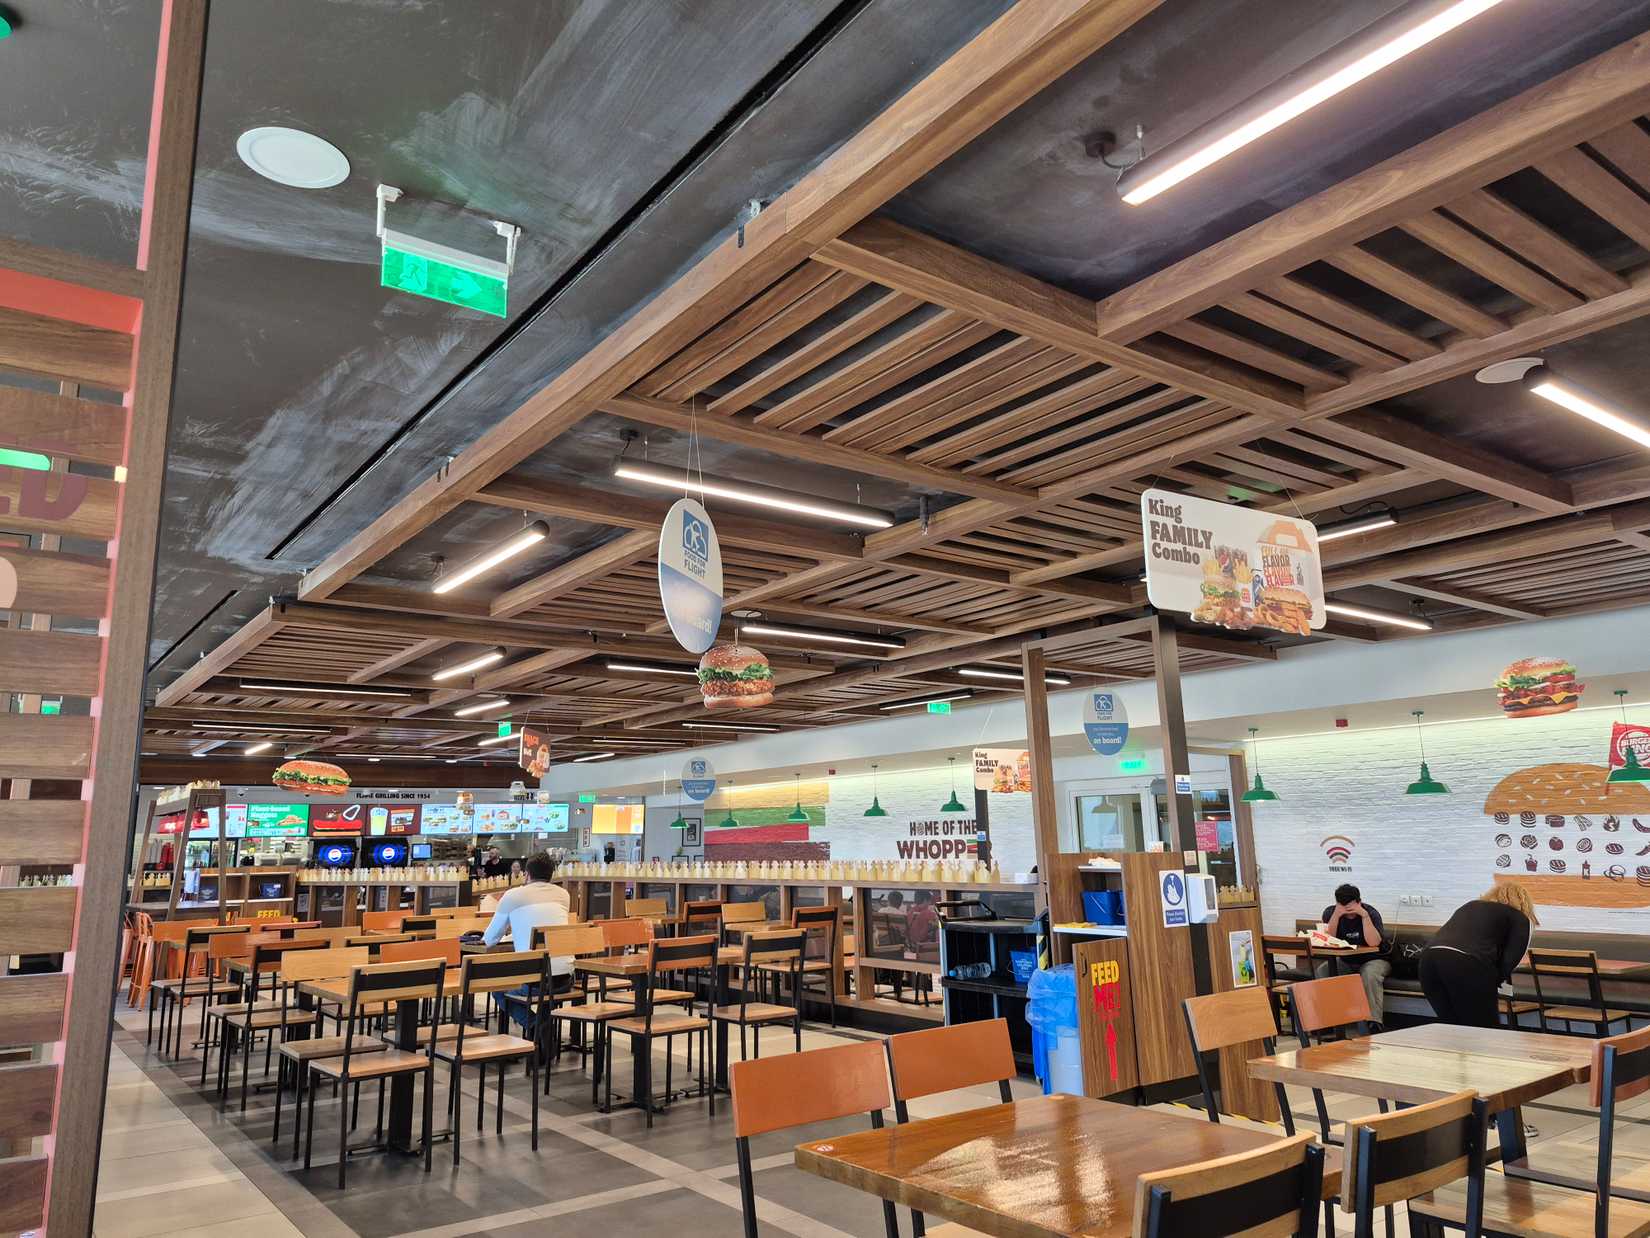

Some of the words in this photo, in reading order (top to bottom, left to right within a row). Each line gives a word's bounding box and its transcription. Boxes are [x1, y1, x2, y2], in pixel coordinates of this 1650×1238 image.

[1148, 498, 1183, 523] King
[1149, 520, 1213, 550] FAMILY
[1152, 542, 1201, 565] Combo
[684, 559, 706, 577] FLIGHT
[1102, 736, 1122, 744] board!
[975, 759, 999, 767] FAMILY
[909, 820, 939, 836] HOME
[943, 820, 956, 835] OF
[959, 819, 978, 834] THE
[1091, 960, 1120, 986] FEED
